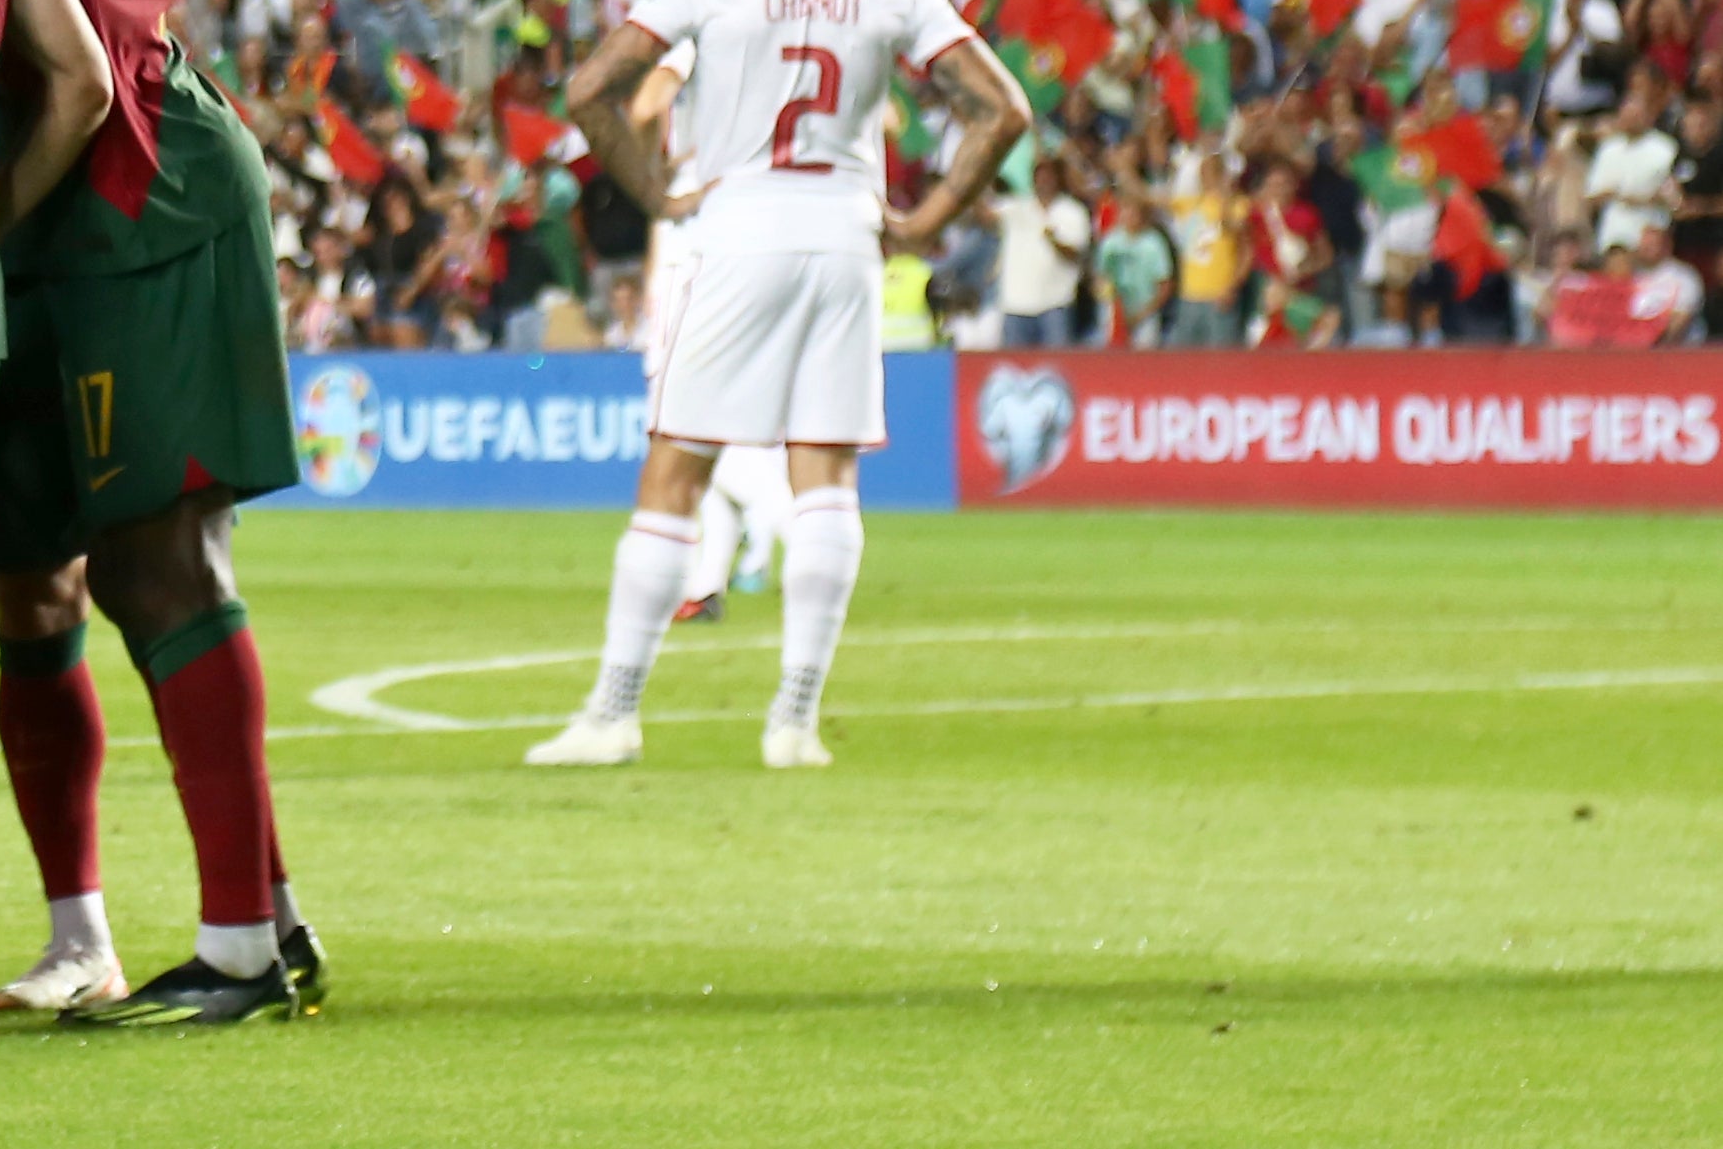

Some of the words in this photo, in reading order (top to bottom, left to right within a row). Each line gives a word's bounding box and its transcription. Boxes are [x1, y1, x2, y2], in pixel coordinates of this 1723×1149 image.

[771, 47, 842, 174] 2
[79, 370, 114, 458] 17
[1084, 396, 1377, 463] EUROPEAN
[1393, 395, 1719, 464] QUALIFIERS
